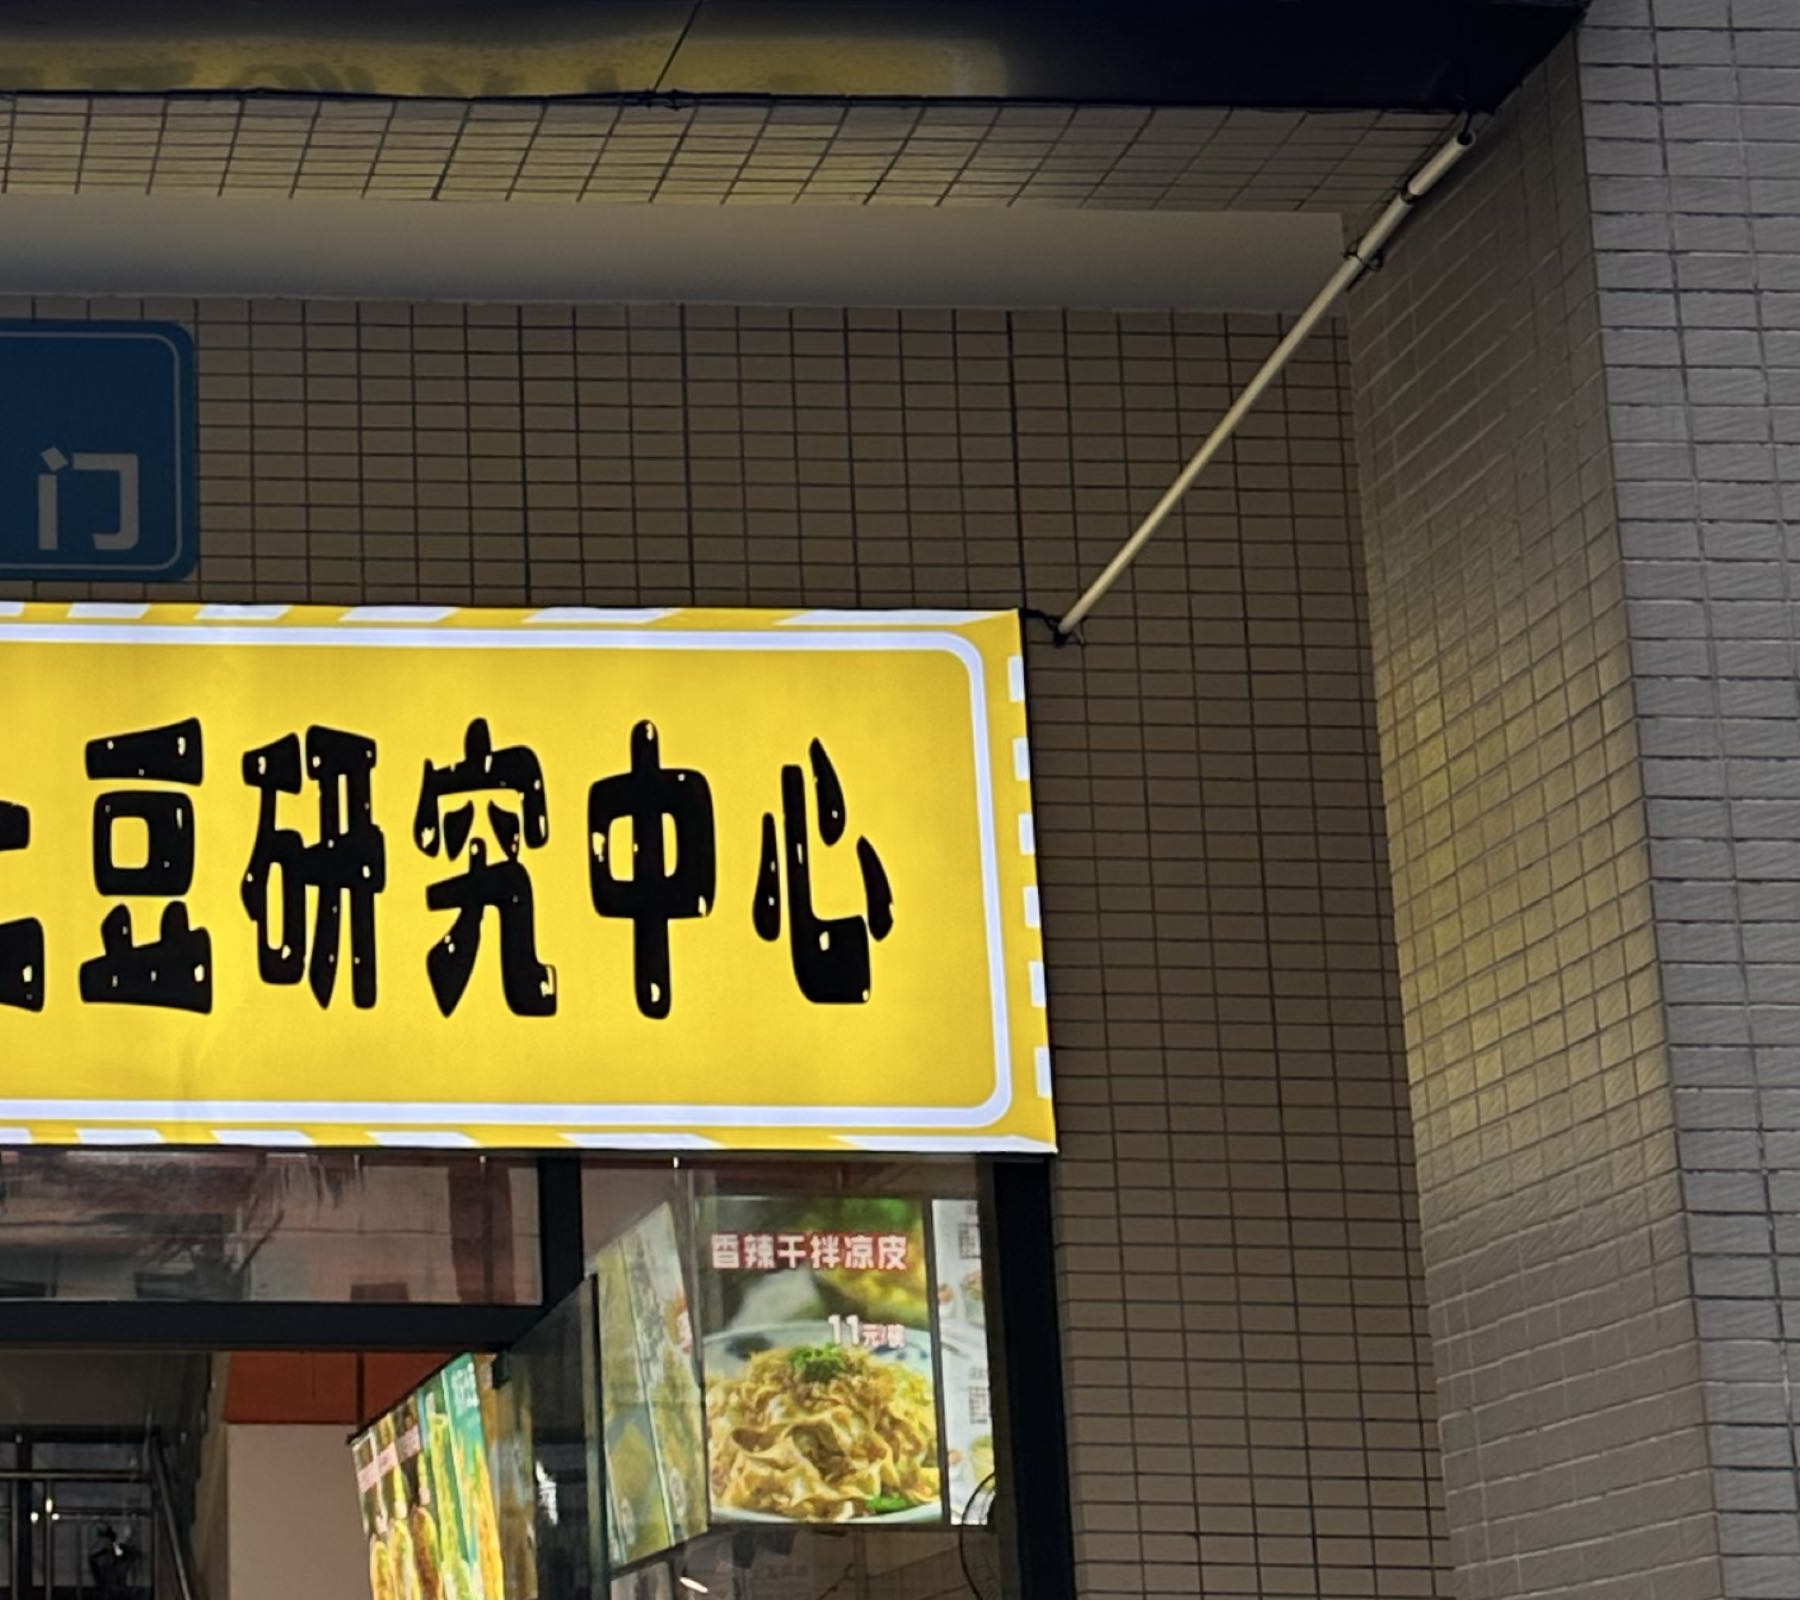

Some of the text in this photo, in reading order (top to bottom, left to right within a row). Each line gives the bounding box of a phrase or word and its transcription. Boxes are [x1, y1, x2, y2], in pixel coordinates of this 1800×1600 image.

[711, 1234, 908, 1270] 香辣干拌凉皮
